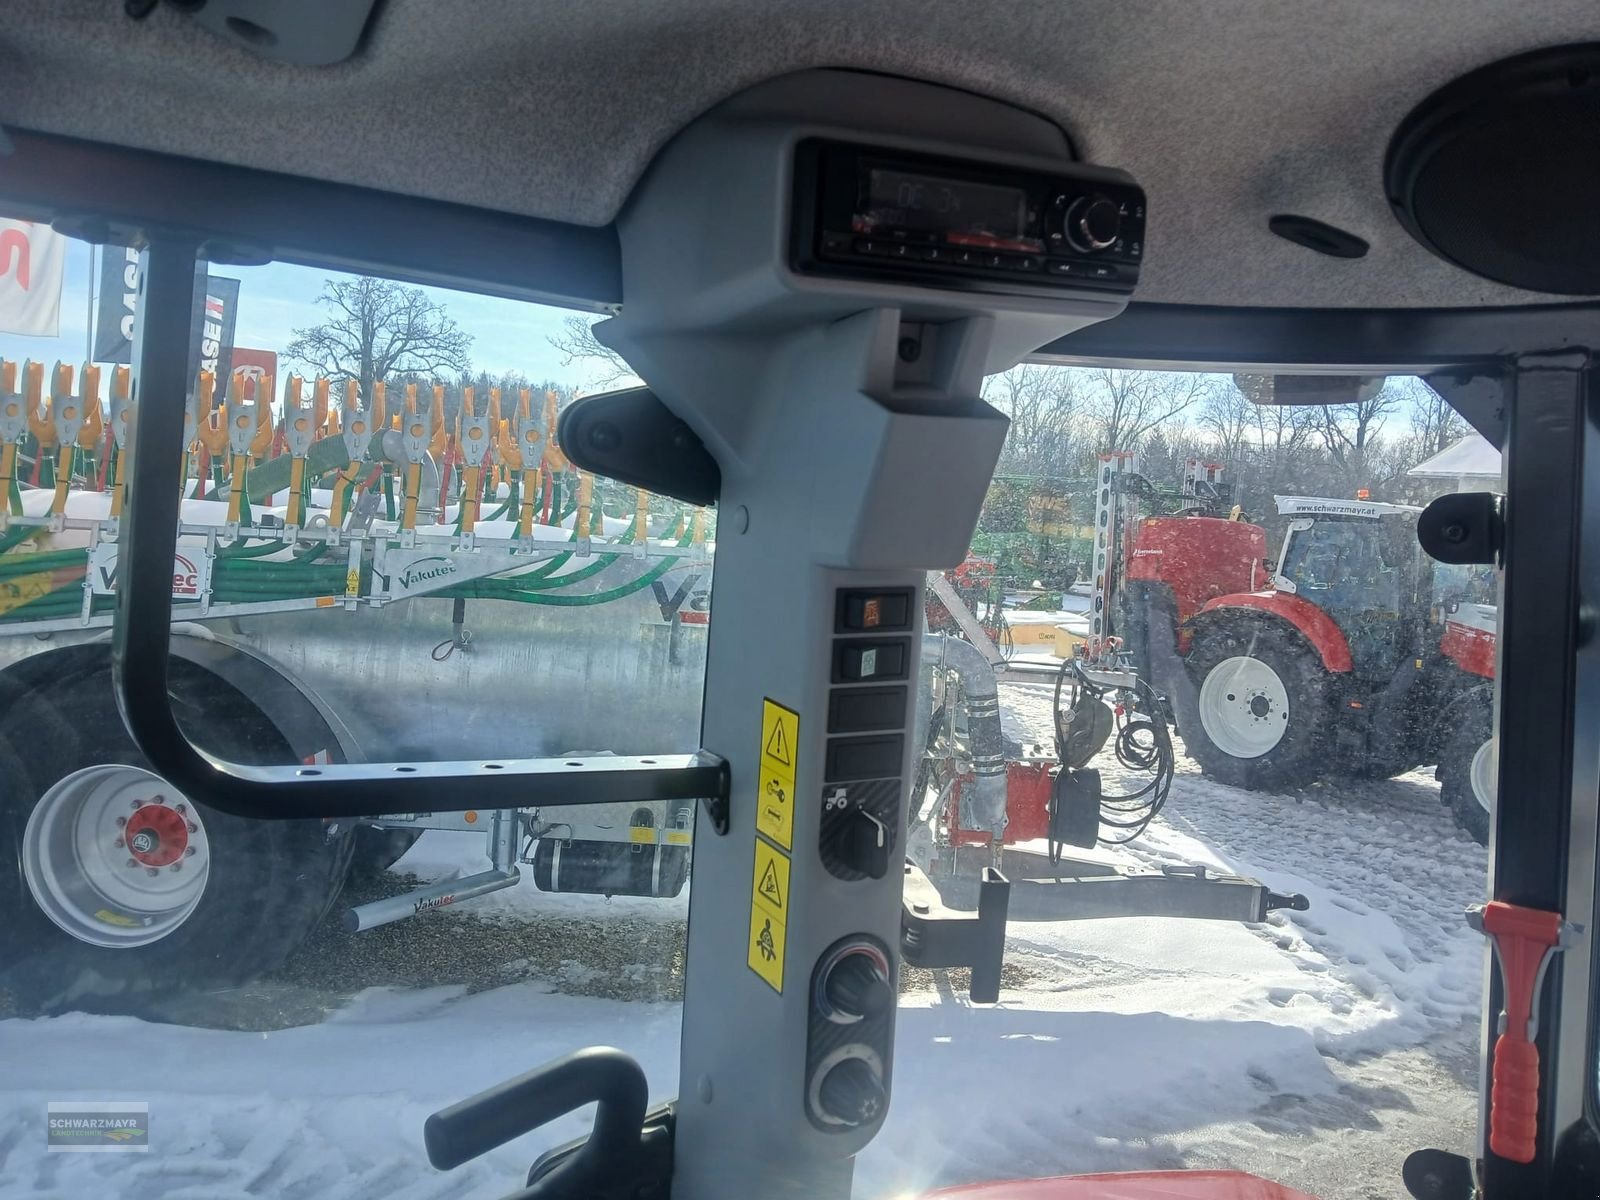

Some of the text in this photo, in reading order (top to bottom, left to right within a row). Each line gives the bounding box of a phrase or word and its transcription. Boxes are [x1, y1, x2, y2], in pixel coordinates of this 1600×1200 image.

[1296, 504, 1376, 515] www.schwarzmayr.at
[398, 566, 457, 589] Vakutec
[413, 894, 456, 914] Vakutec
